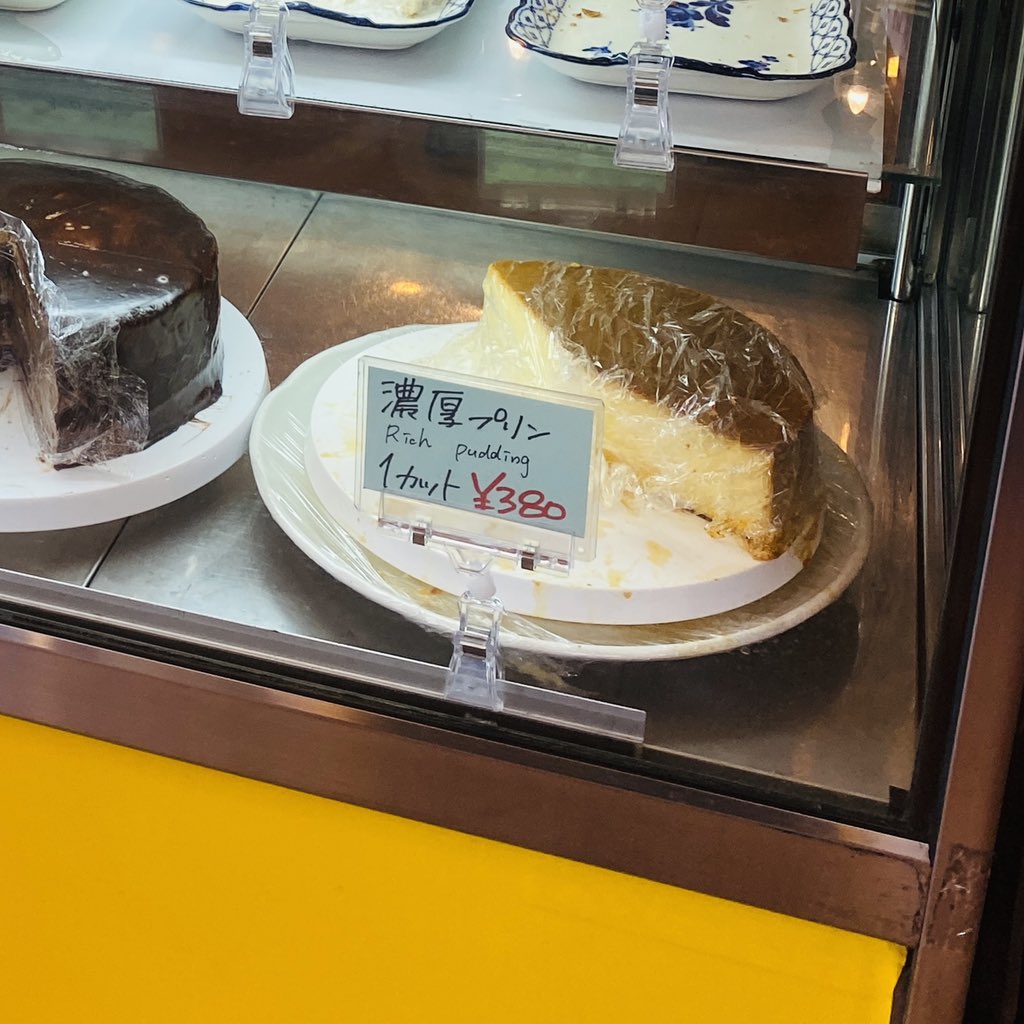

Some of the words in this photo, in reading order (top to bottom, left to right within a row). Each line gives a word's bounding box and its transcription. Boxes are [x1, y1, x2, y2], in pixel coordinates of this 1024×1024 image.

[381, 377, 551, 441] 濃厚プリン
[385, 425, 432, 448] Rich
[379, 452, 460, 501] 1カット
[471, 472, 567, 520] ¥380
